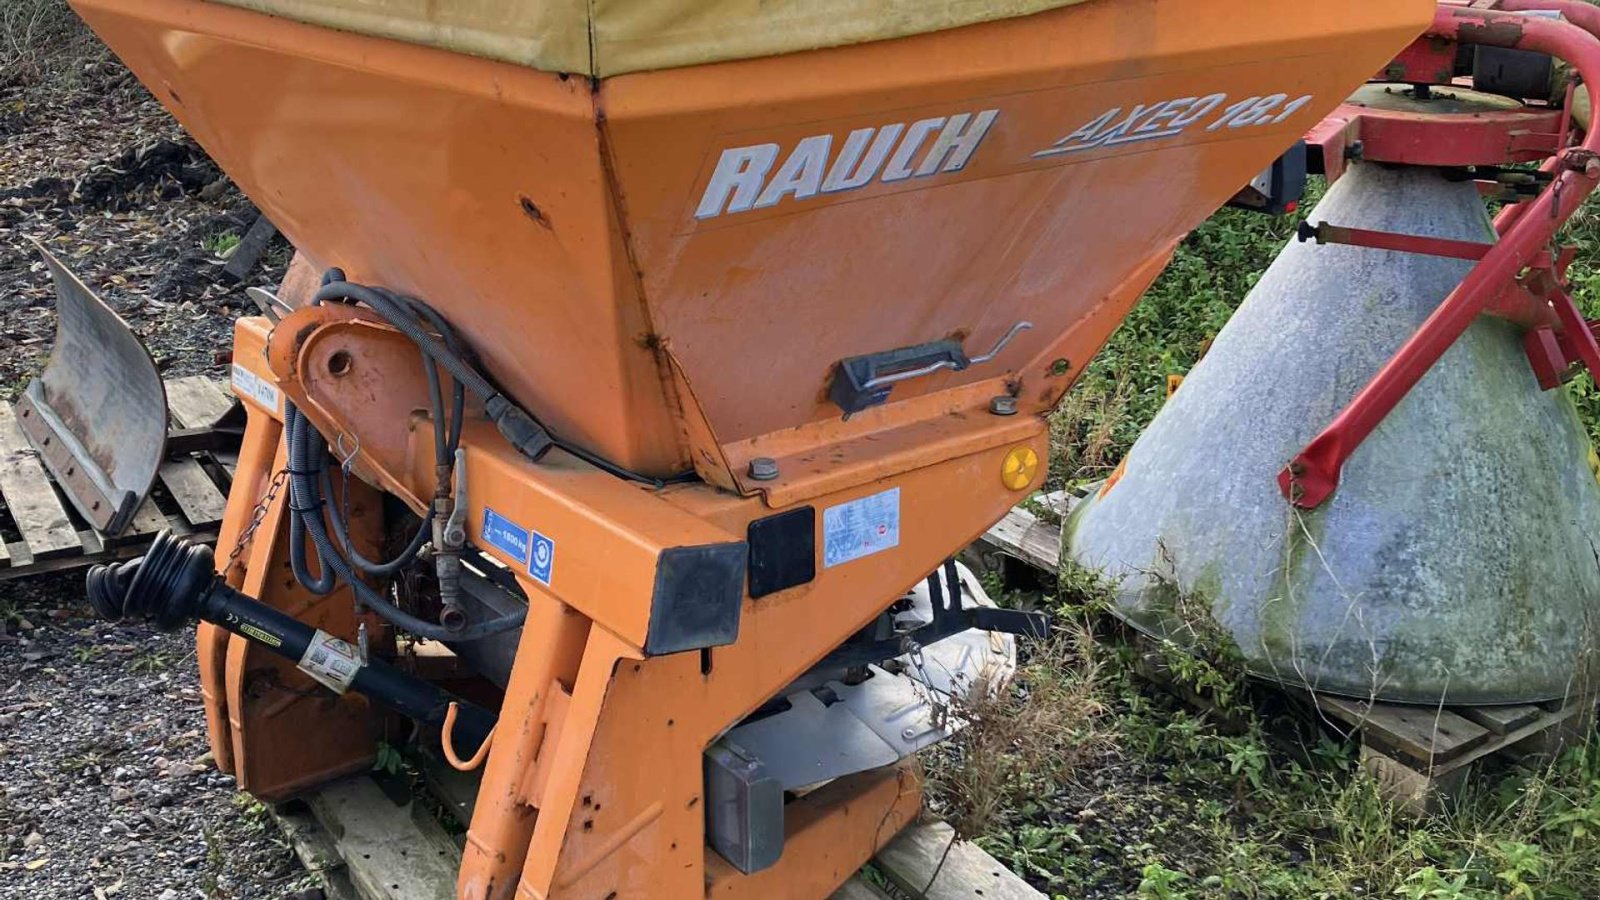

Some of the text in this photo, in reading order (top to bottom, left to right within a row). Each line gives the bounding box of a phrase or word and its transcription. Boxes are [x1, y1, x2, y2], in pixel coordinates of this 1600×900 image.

[694, 109, 1000, 219] RAUCH
[1031, 92, 1314, 158] AXEO 18.1
